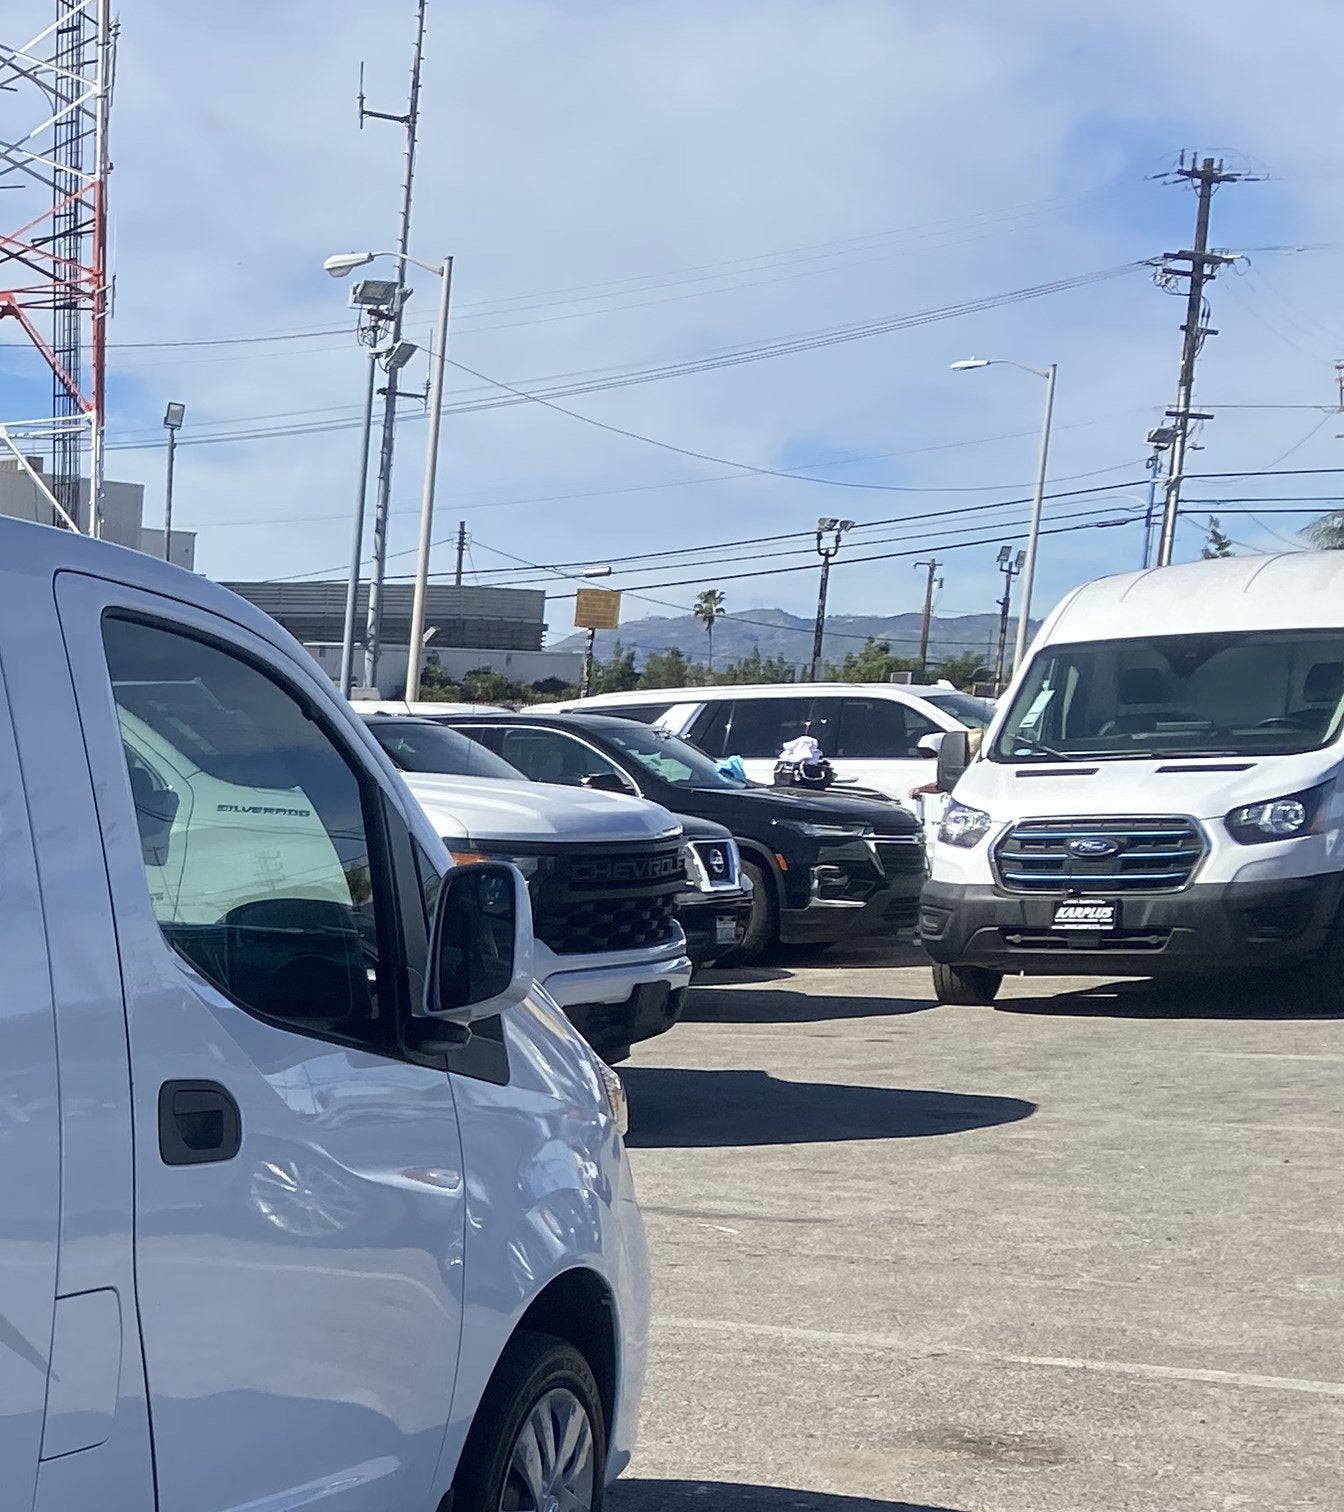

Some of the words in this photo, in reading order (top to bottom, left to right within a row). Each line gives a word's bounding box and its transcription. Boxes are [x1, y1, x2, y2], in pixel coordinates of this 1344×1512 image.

[217, 804, 310, 817] SILVERADO
[572, 855, 685, 881] CHEVROLE
[1055, 906, 1114, 919] KARPLUS
